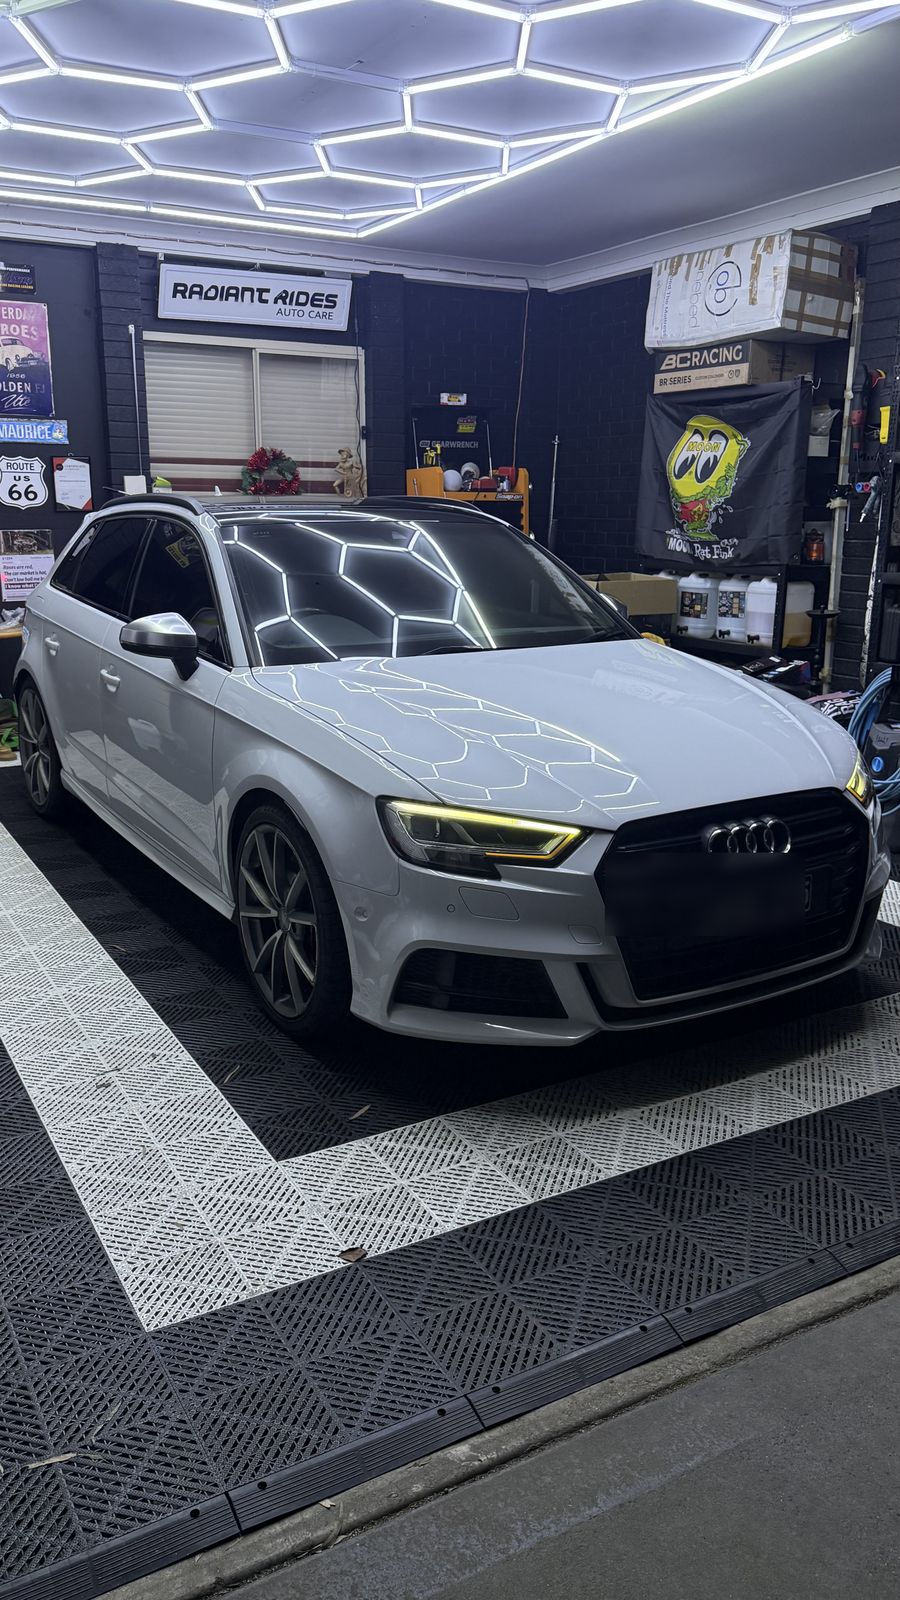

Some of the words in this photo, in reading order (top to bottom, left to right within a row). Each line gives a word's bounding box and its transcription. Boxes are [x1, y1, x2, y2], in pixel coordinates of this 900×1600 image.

[172, 282, 271, 304] RADIANT
[273, 289, 338, 310] RIDES
[689, 266, 705, 328] nebed
[276, 308, 305, 318] AUTO
[308, 310, 334, 320] CARE
[0, 381, 31, 393] LDEN
[659, 376, 668, 387] BR
[669, 375, 692, 384] SERIES
[0, 423, 52, 439] MAURICE
[686, 441, 721, 453] MOON
[6, 462, 35, 471] ROUTE
[8, 484, 38, 501] 66
[712, 544, 735, 559] Fink
